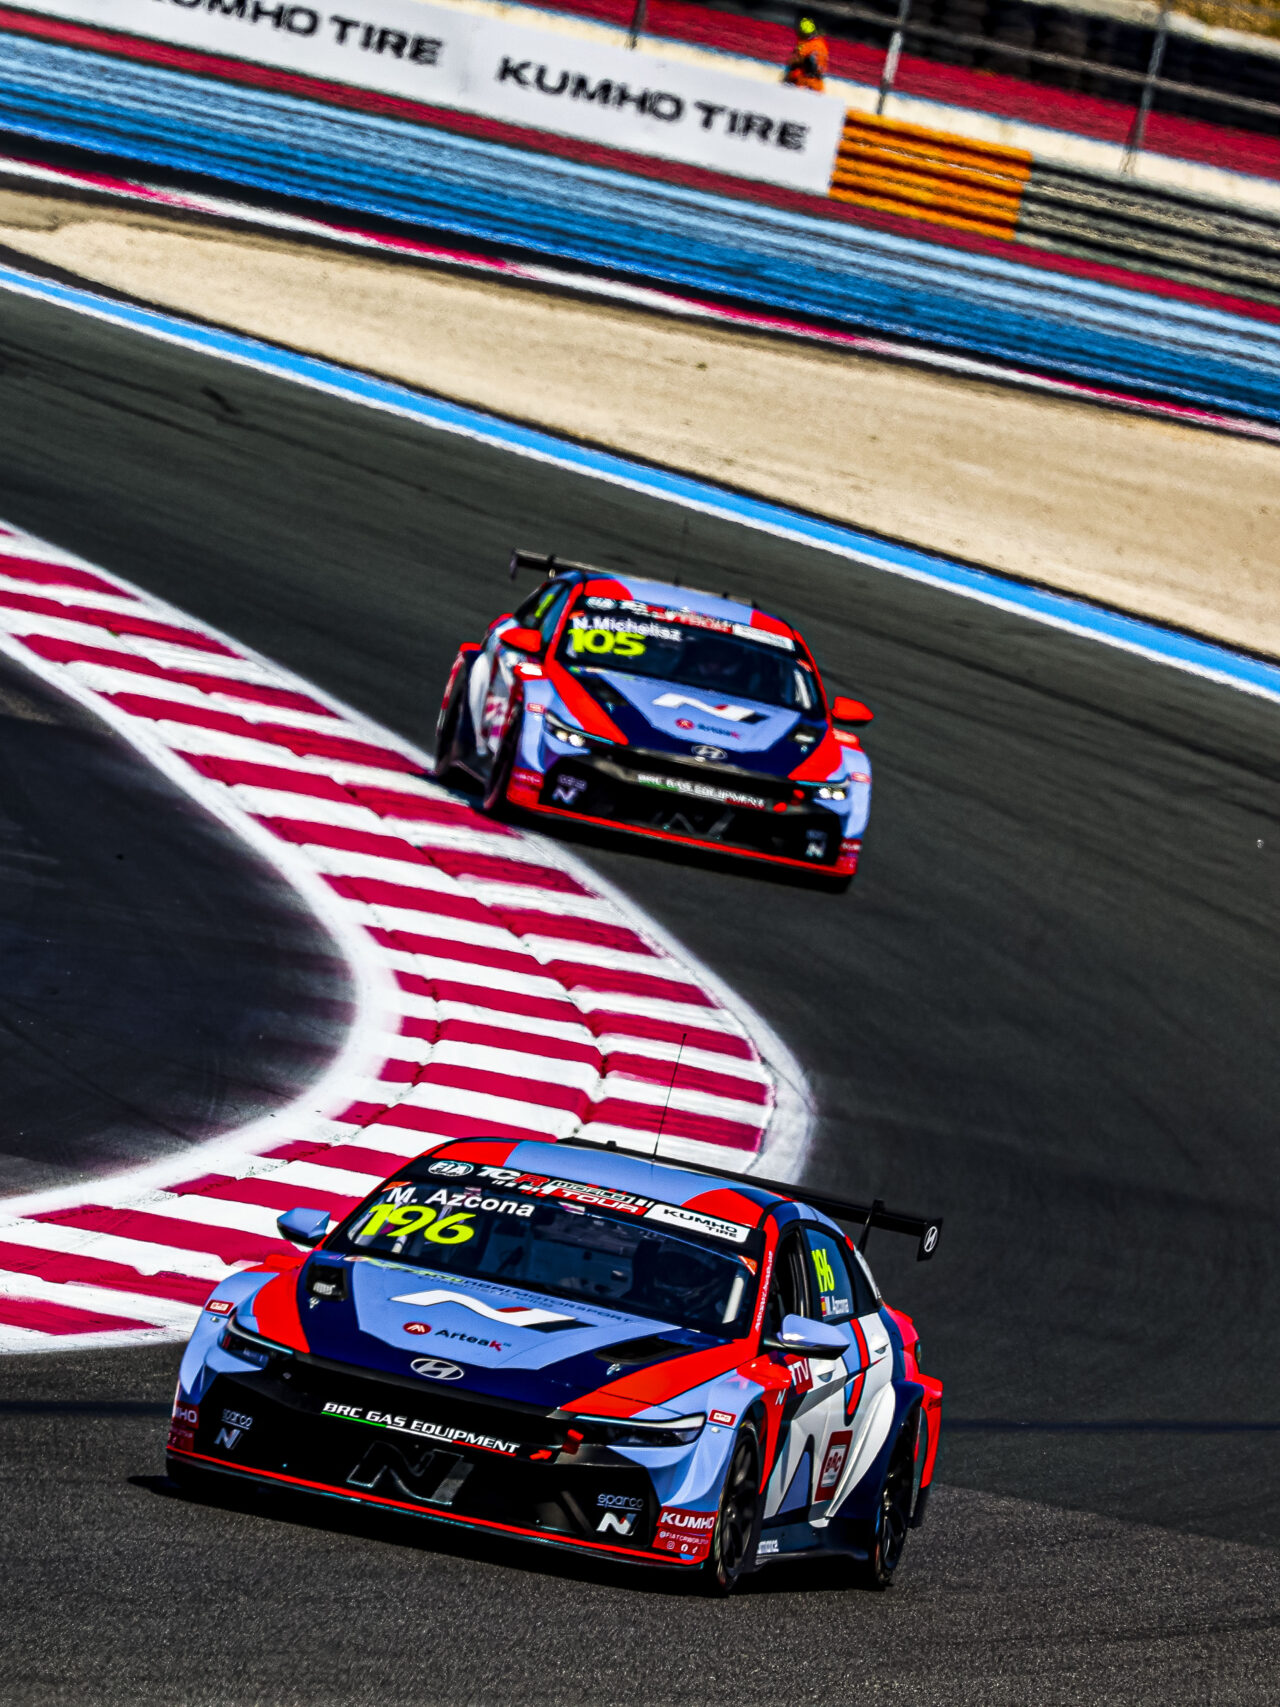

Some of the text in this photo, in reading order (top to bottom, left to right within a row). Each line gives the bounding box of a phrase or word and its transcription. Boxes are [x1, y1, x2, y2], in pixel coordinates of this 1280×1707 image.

[153, 0, 442, 66] MHO TIRE
[498, 55, 809, 150] KUMHO TIRE
[568, 628, 647, 656] 105
[432, 1162, 466, 1175] FIA
[477, 1166, 550, 1188] TCR
[386, 1186, 536, 1218] M. Azcona
[561, 1189, 640, 1213] TOUR
[360, 1203, 477, 1245] 196
[663, 1208, 739, 1234] KUMHO
[706, 1225, 738, 1238] TIRE
[811, 1248, 835, 1292] 196
[435, 1328, 503, 1352] Arteak
[323, 1402, 521, 1454] BRC GAS EQUIPMENT
[597, 1493, 644, 1509] sparco
[660, 1511, 715, 1530] KUMHO
